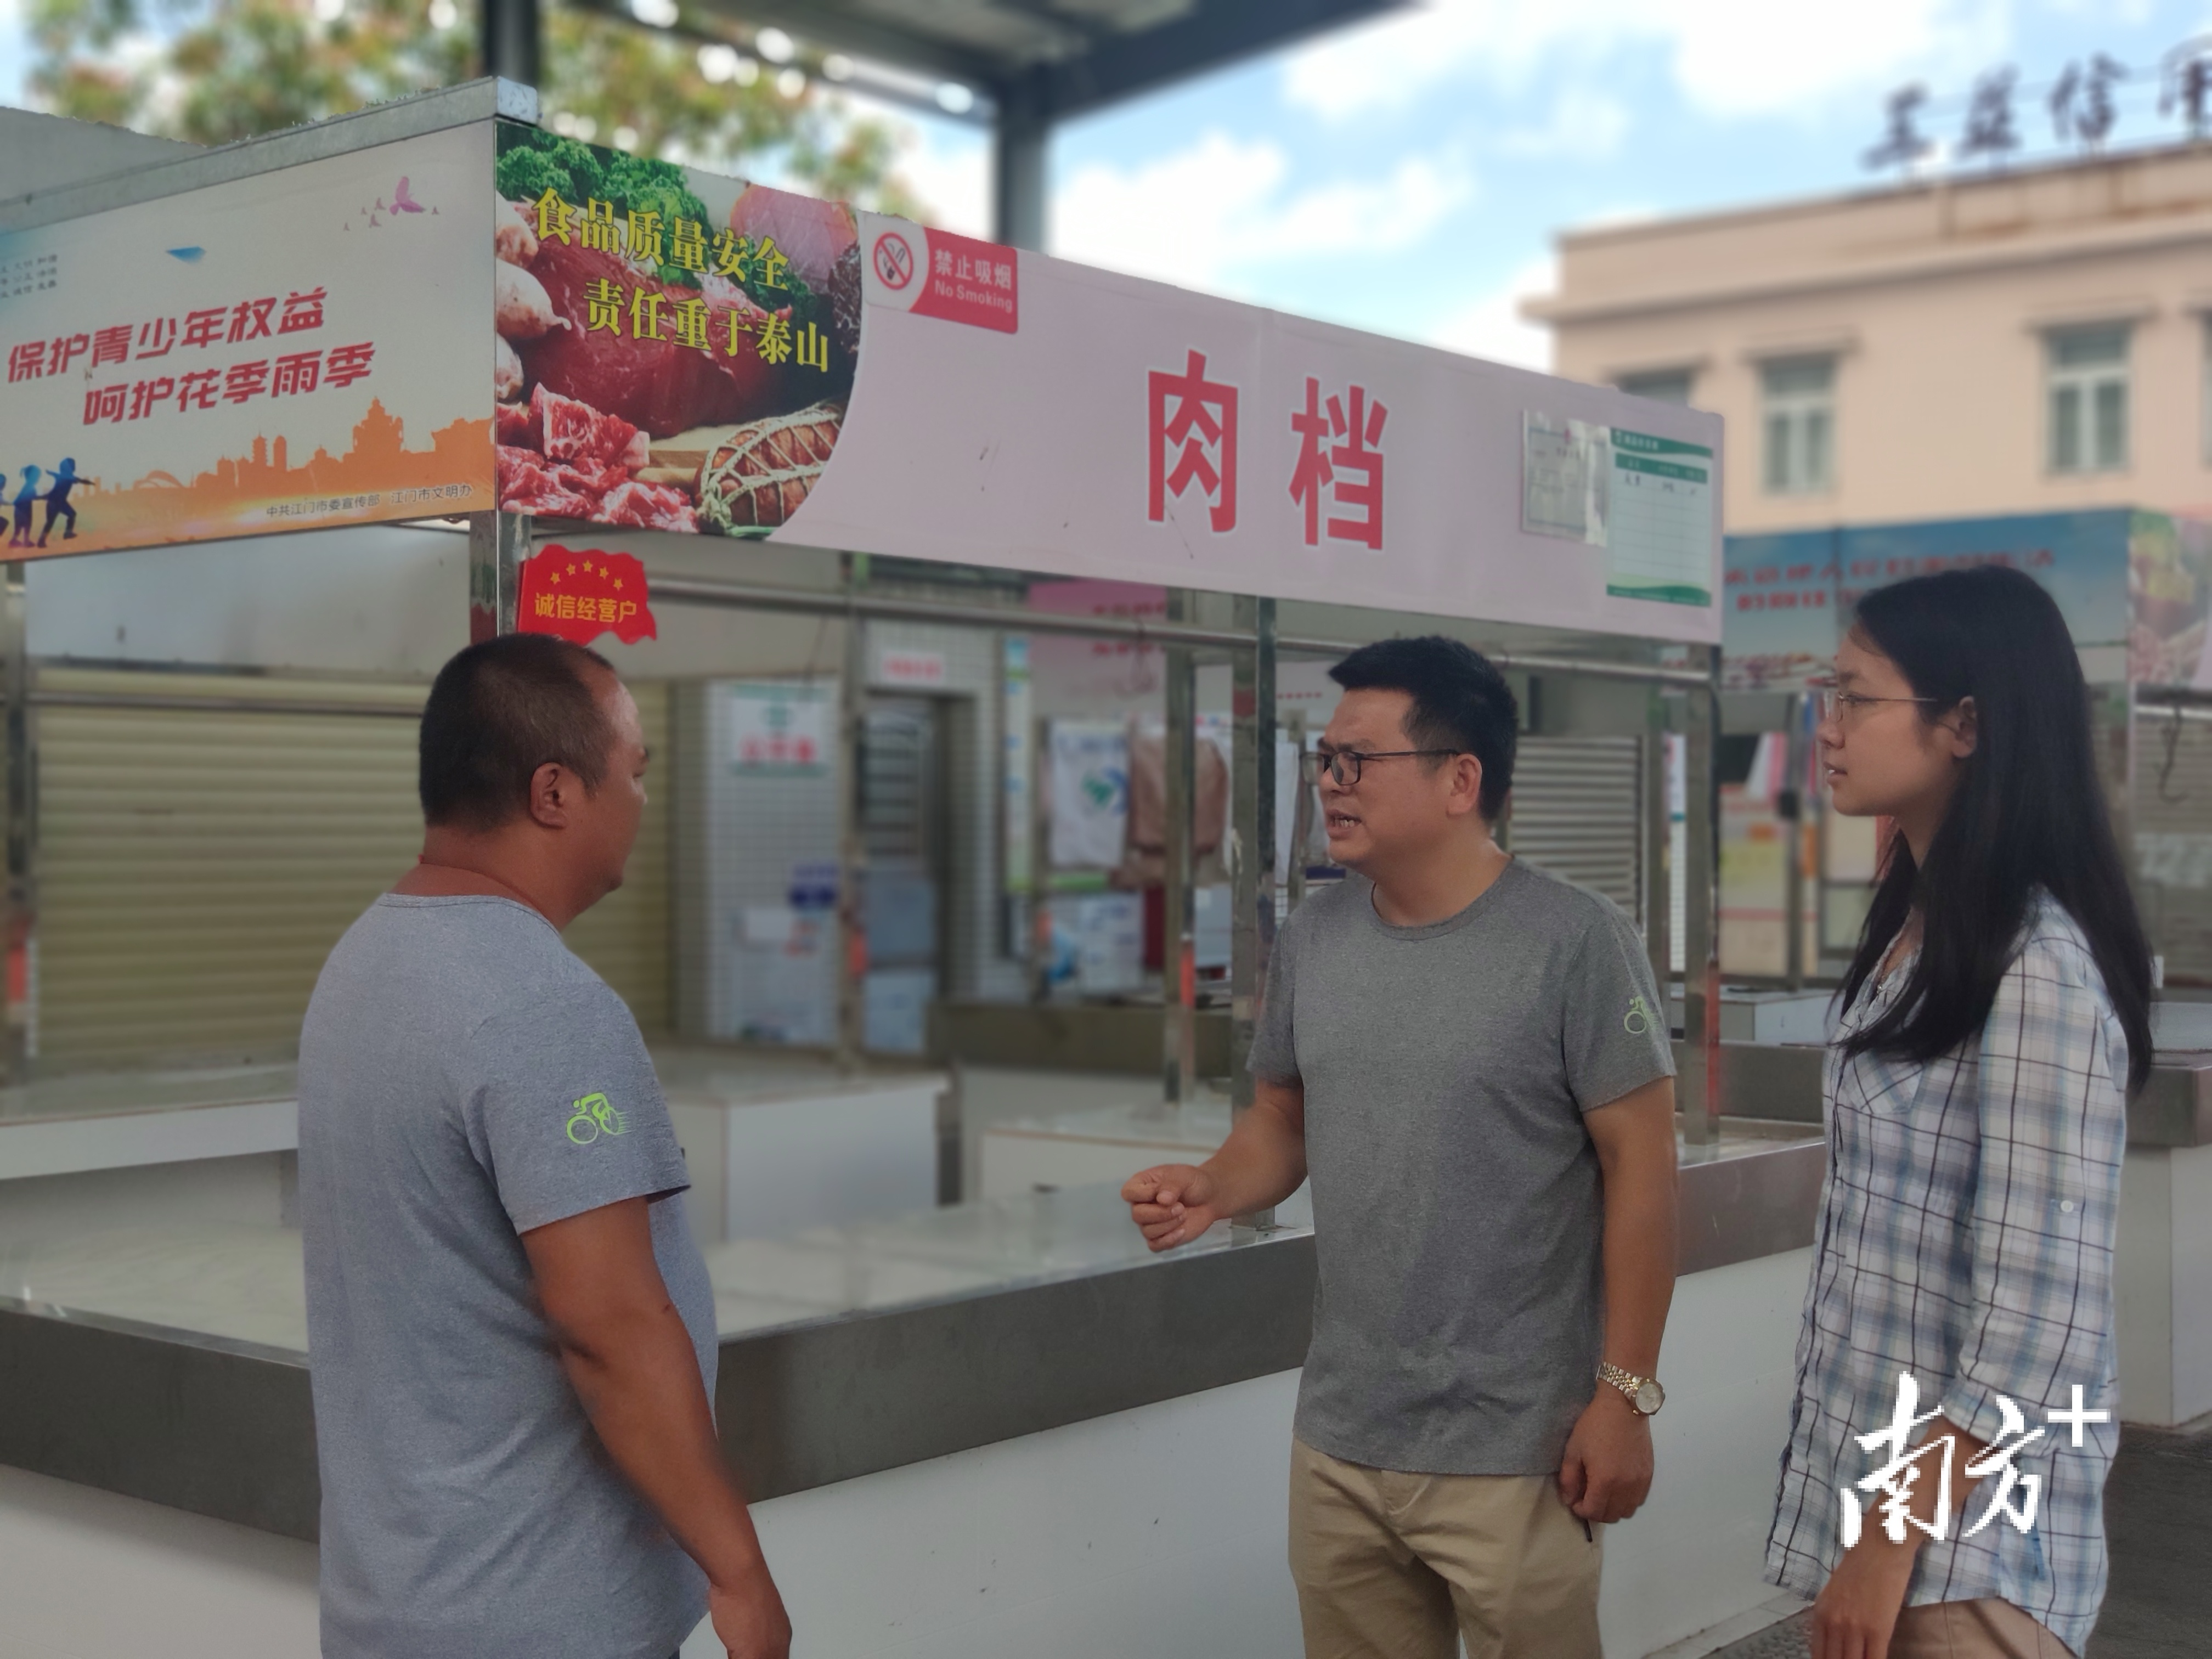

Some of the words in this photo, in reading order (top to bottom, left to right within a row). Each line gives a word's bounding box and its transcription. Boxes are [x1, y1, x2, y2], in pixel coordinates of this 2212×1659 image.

[532, 188, 789, 292] 食品质量安全
[935, 249, 1012, 291] 禁止吸烟
[8, 286, 328, 383] 保护青少年权益
[583, 278, 829, 373] 责任重于泰山
[935, 279, 953, 297] No
[956, 284, 1013, 314] Smoking
[83, 342, 375, 425] 呵护花季雨季
[1148, 348, 1388, 550] 肉档
[266, 494, 380, 517] 中共江门市委宣传部
[390, 484, 472, 504] 江门市文明办
[535, 592, 637, 623] 诚信经营户
